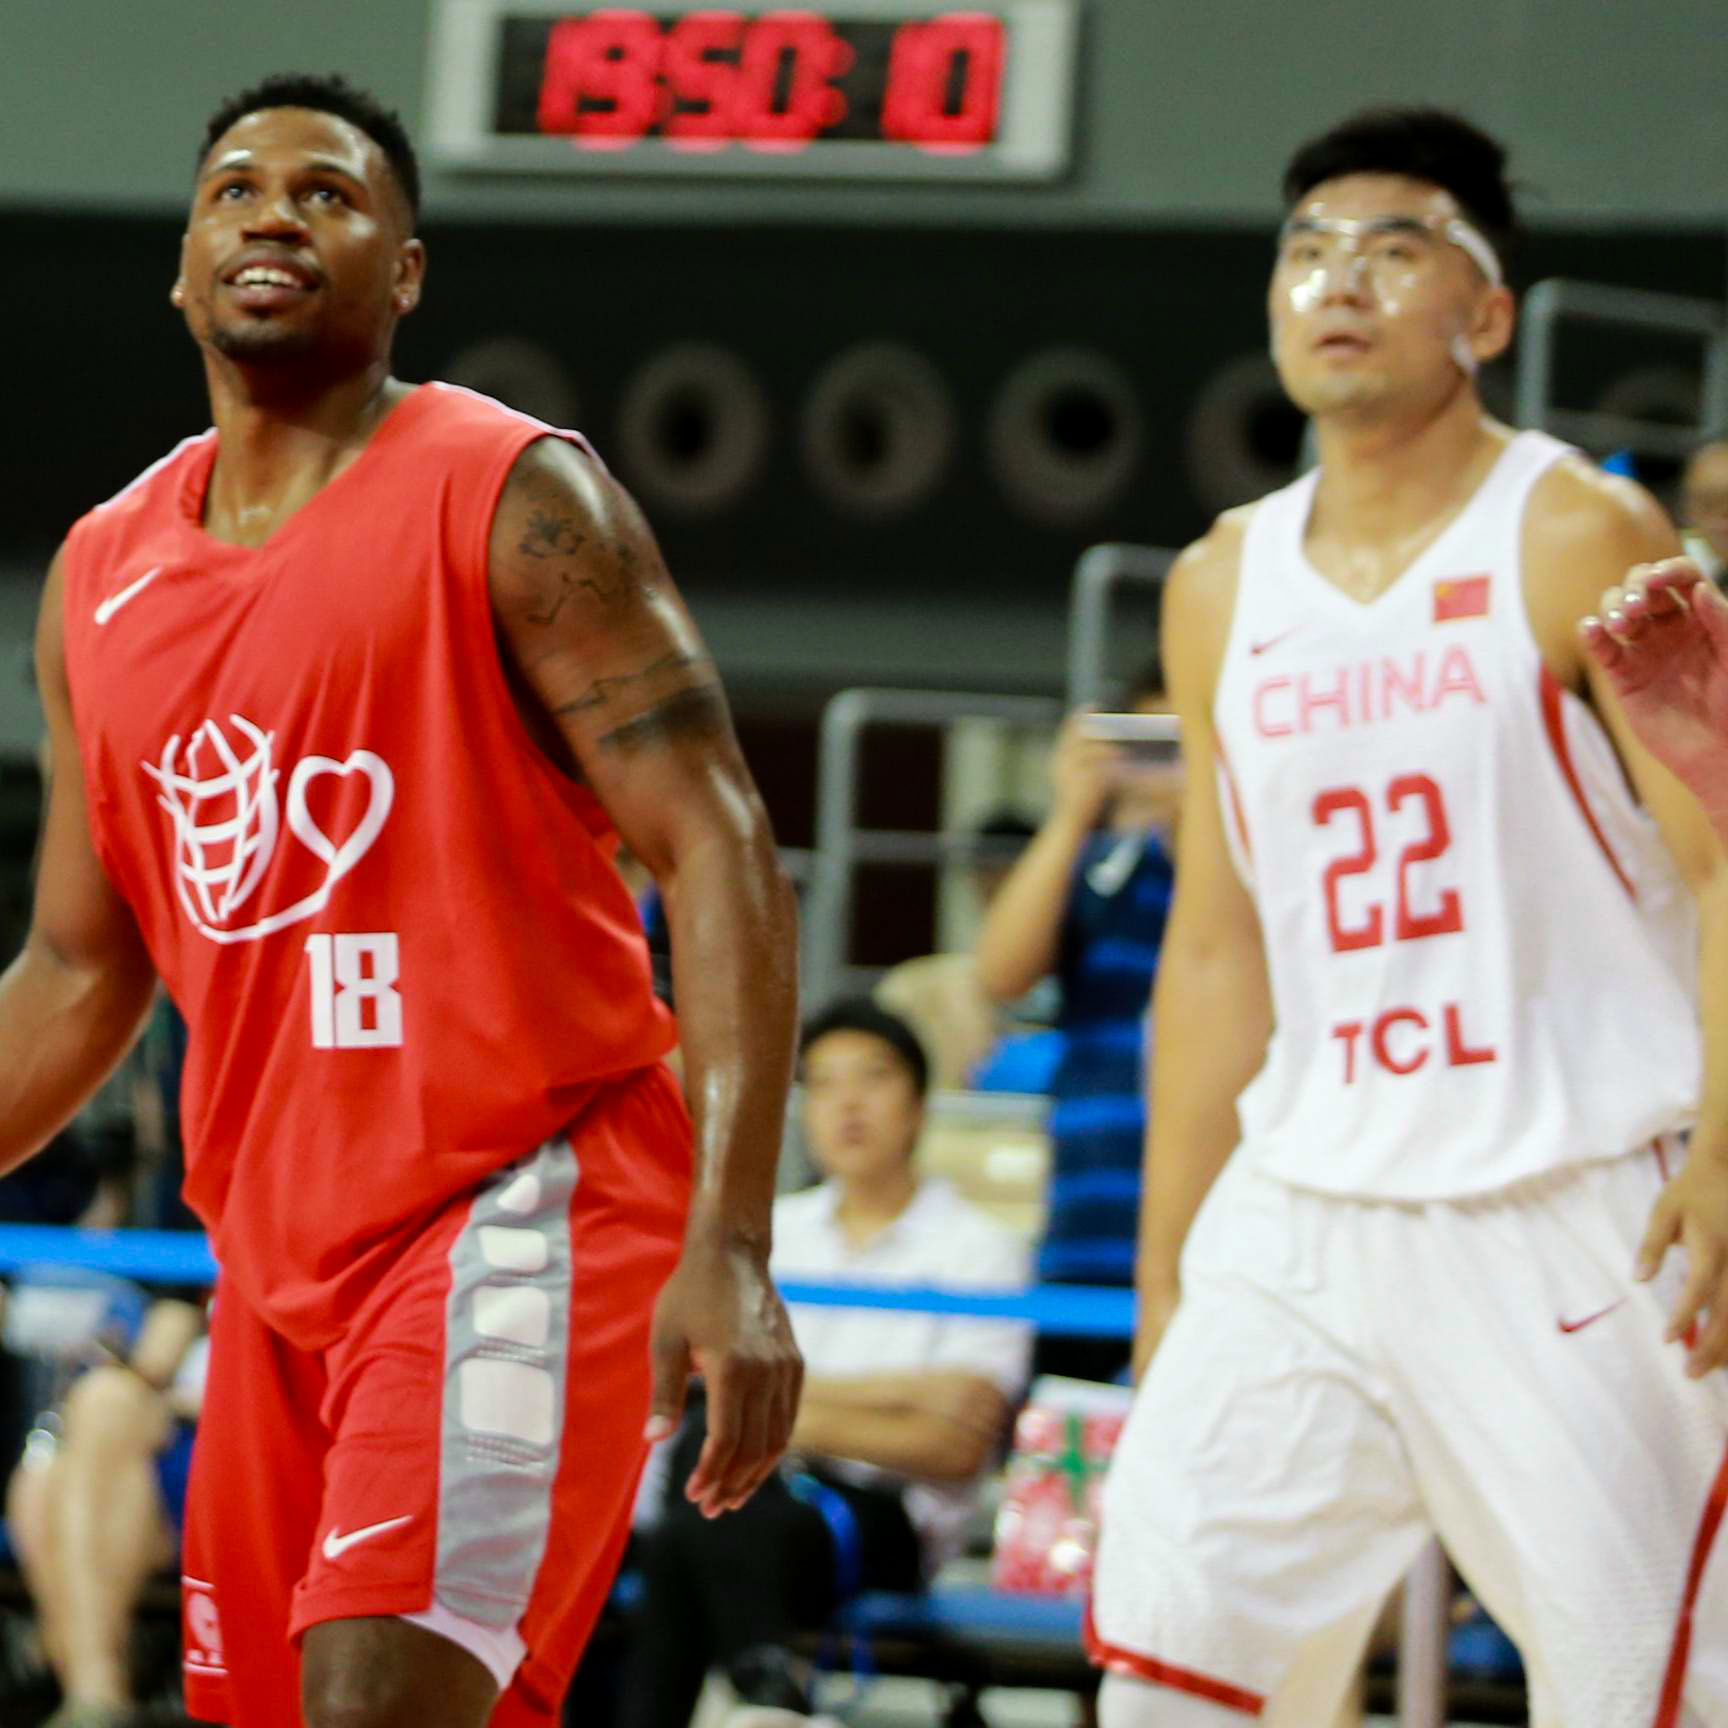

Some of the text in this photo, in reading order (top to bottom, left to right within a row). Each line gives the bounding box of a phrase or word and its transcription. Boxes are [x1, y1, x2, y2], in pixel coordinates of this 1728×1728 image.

[1251, 642, 1488, 741] CHINA
[1311, 772, 1466, 954] 22
[304, 931, 404, 1050] 18
[1331, 1002, 1498, 1086] TCL
